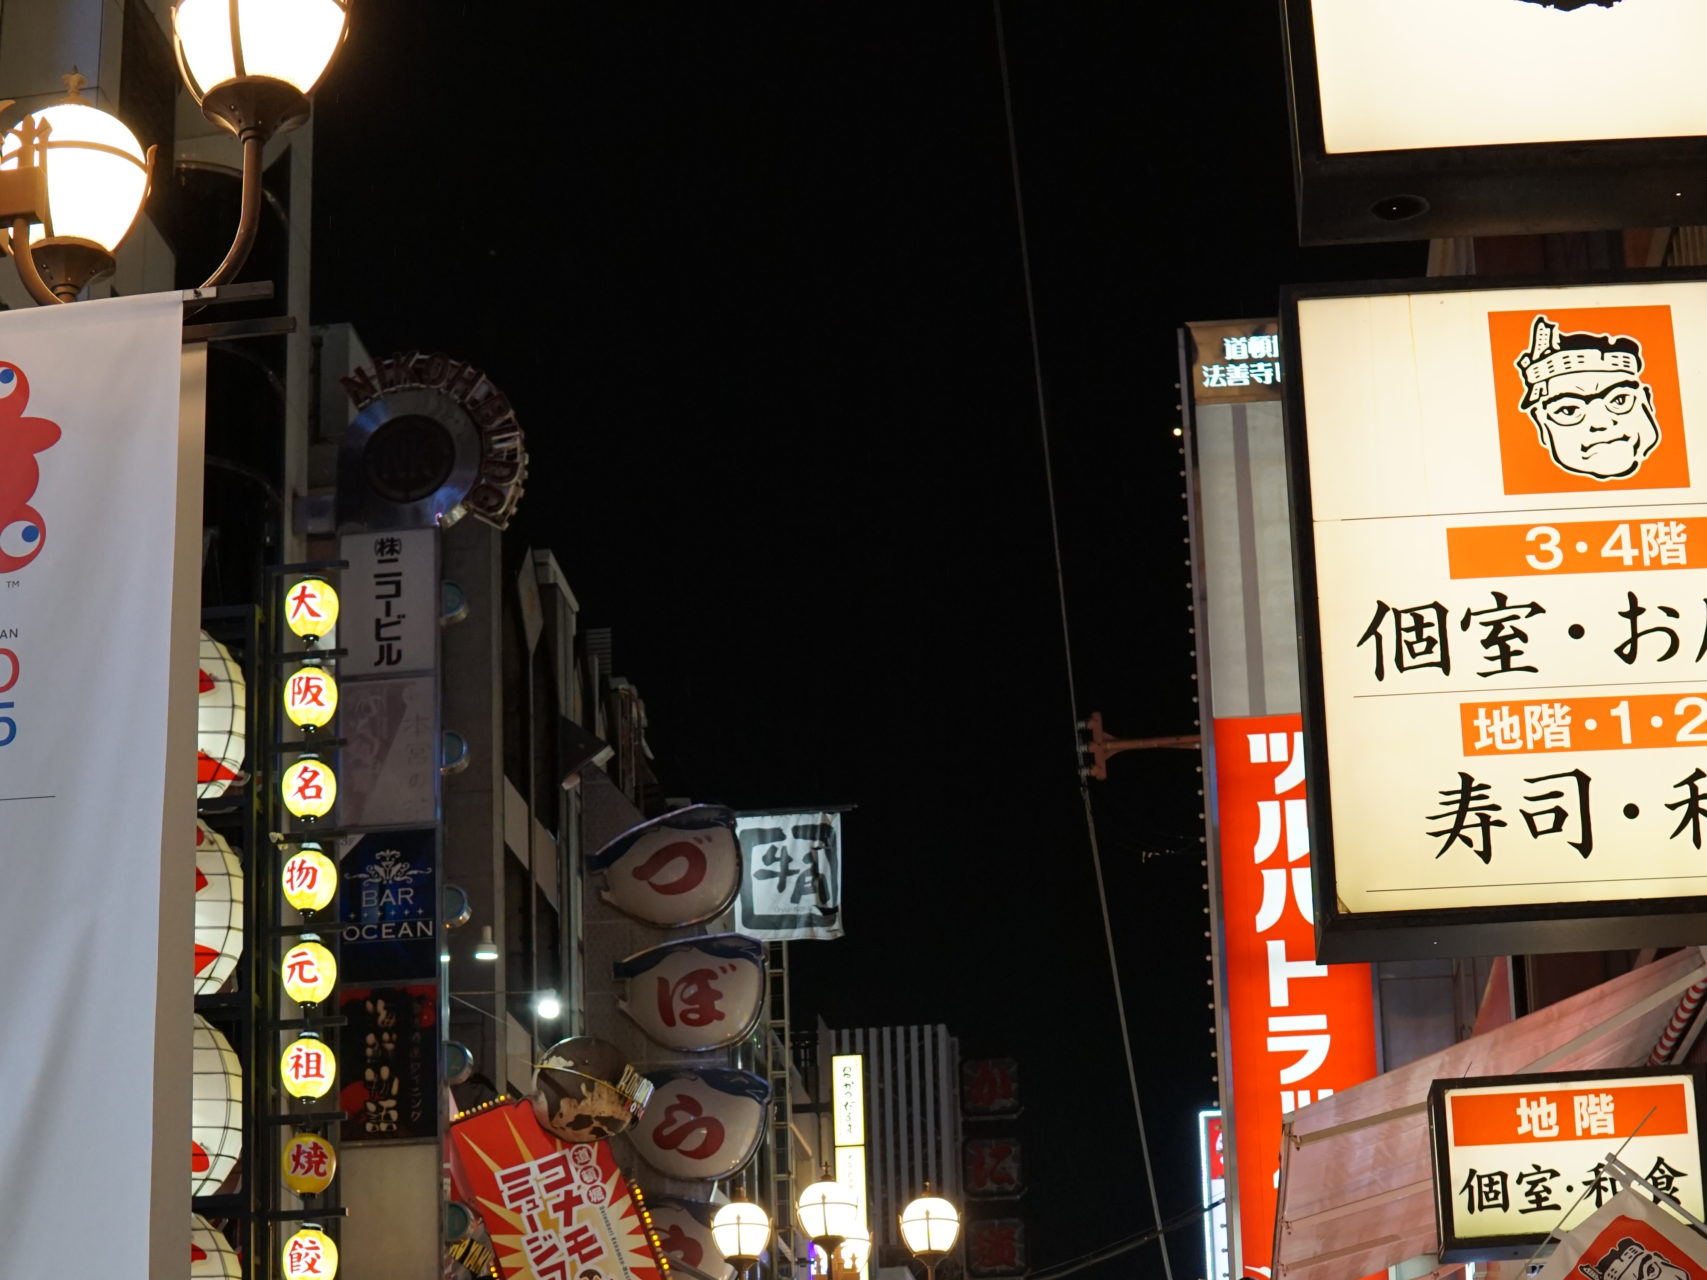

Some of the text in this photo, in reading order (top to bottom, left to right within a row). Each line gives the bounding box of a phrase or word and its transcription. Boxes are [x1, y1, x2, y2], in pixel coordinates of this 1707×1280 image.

[1223, 334, 1280, 360] 道頓
[1202, 362, 1281, 388] 法善寺
[1525, 521, 1687, 571] 3・4階
[7, 580, 20, 588] TM
[1356, 591, 1707, 682] 個室・お
[754, 845, 831, 905] 牛角
[362, 887, 415, 908] BAR
[343, 920, 433, 941] OCEAN
[1516, 1093, 1616, 1138] 地階
